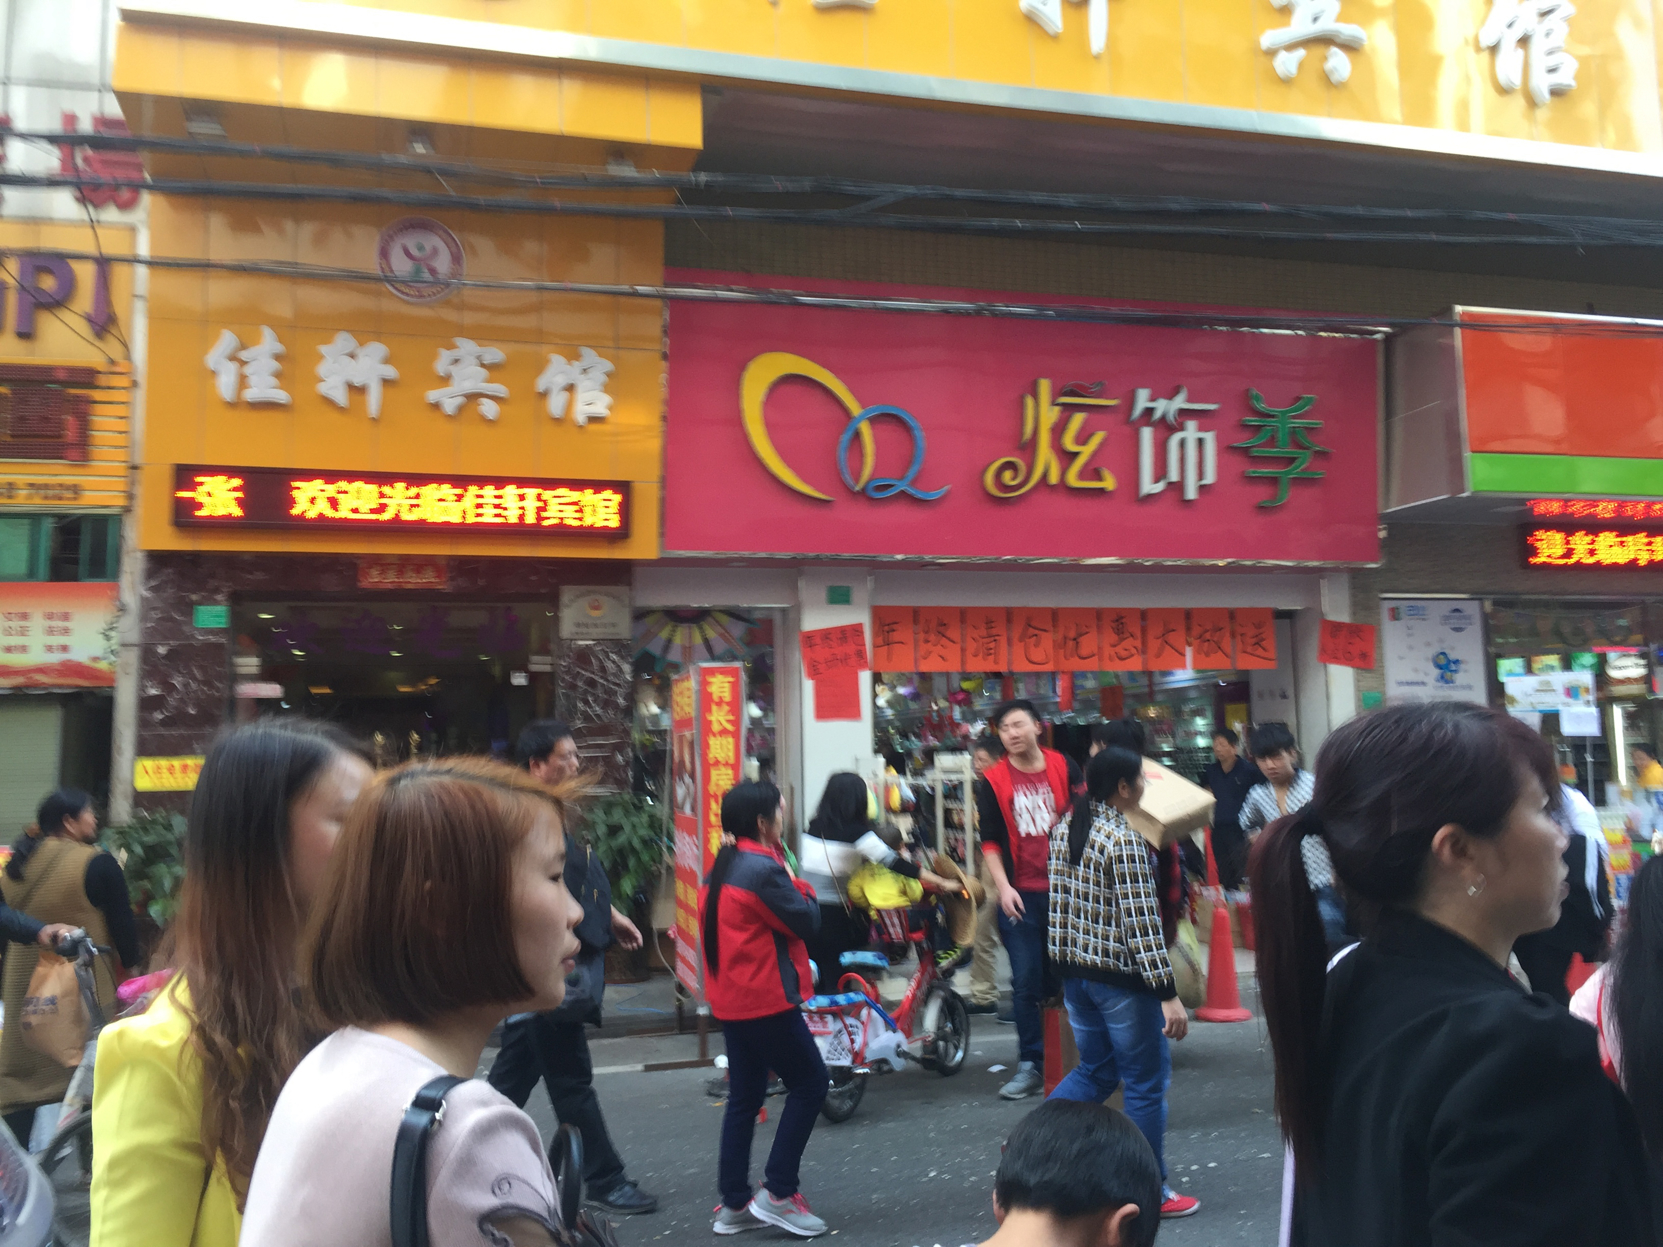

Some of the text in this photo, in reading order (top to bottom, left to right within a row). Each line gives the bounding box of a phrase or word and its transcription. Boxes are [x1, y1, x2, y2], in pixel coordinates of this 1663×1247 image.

[204, 324, 616, 426] 佳轩宾馆
[983, 378, 1335, 508] 炫饰季
[289, 479, 623, 529] 欢迎光临佳轩宾馆
[875, 612, 1277, 665] 年终清仓优惠大放送
